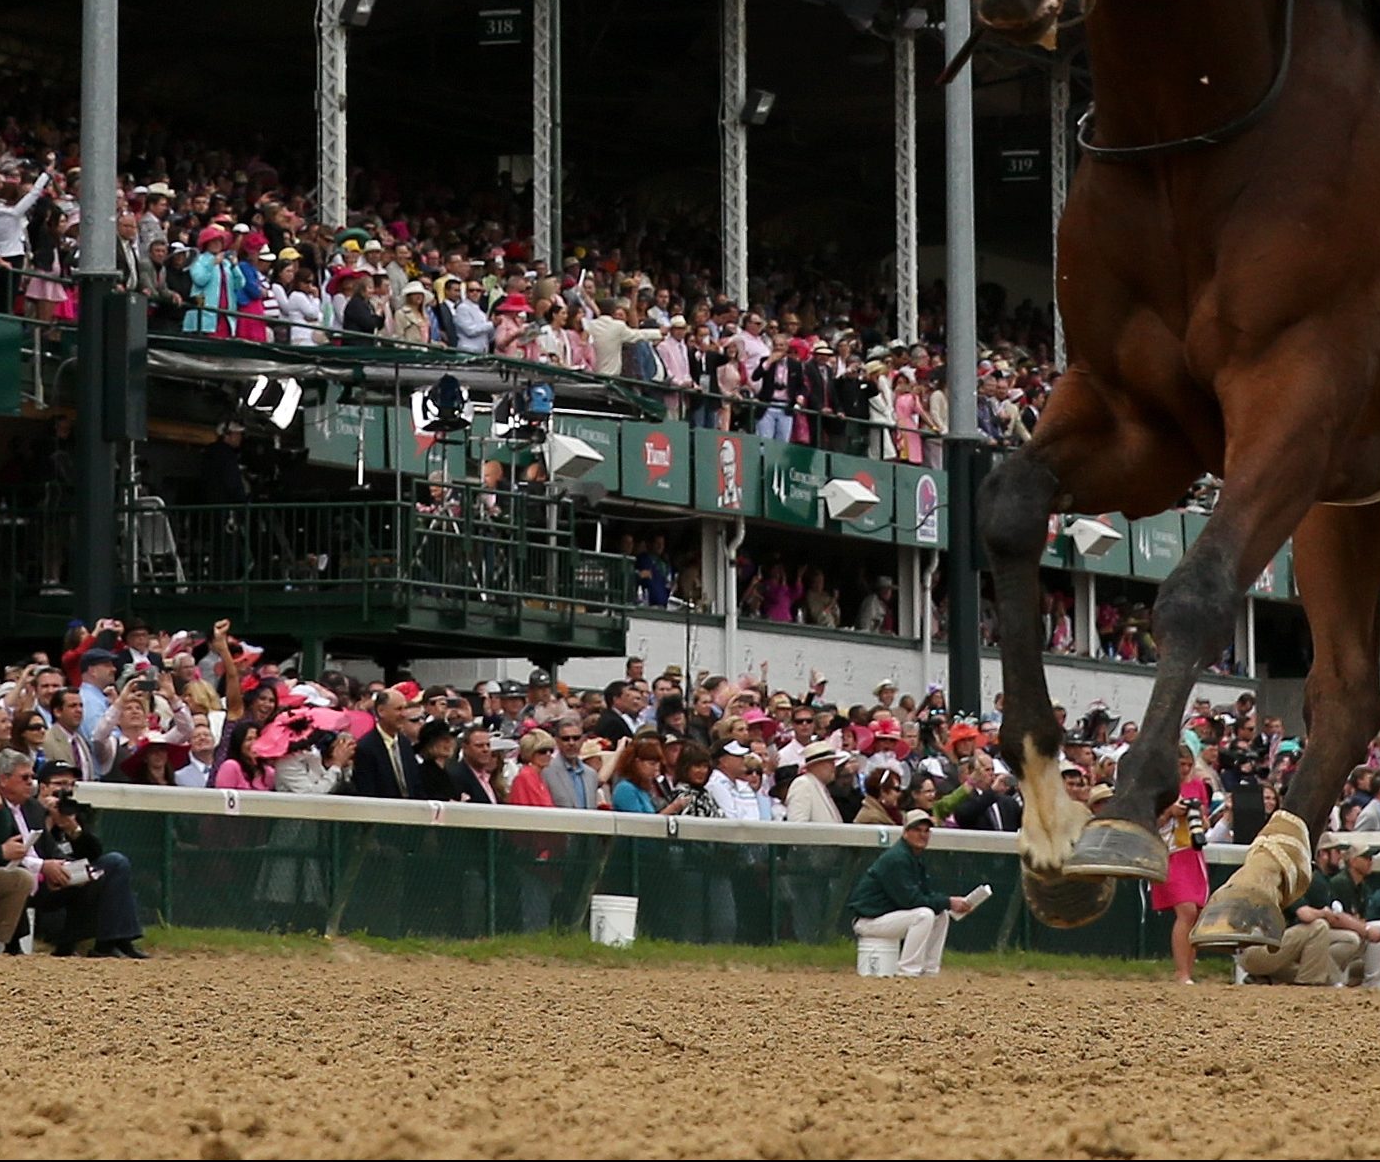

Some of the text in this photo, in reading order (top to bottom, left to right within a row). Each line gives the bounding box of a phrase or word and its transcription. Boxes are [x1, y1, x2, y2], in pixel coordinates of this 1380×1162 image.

[486, 19, 513, 34] 318
[1007, 158, 1032, 173] 319
[645, 442, 671, 466] Yum!
[227, 790, 236, 809] 8
[433, 802, 441, 820] 7
